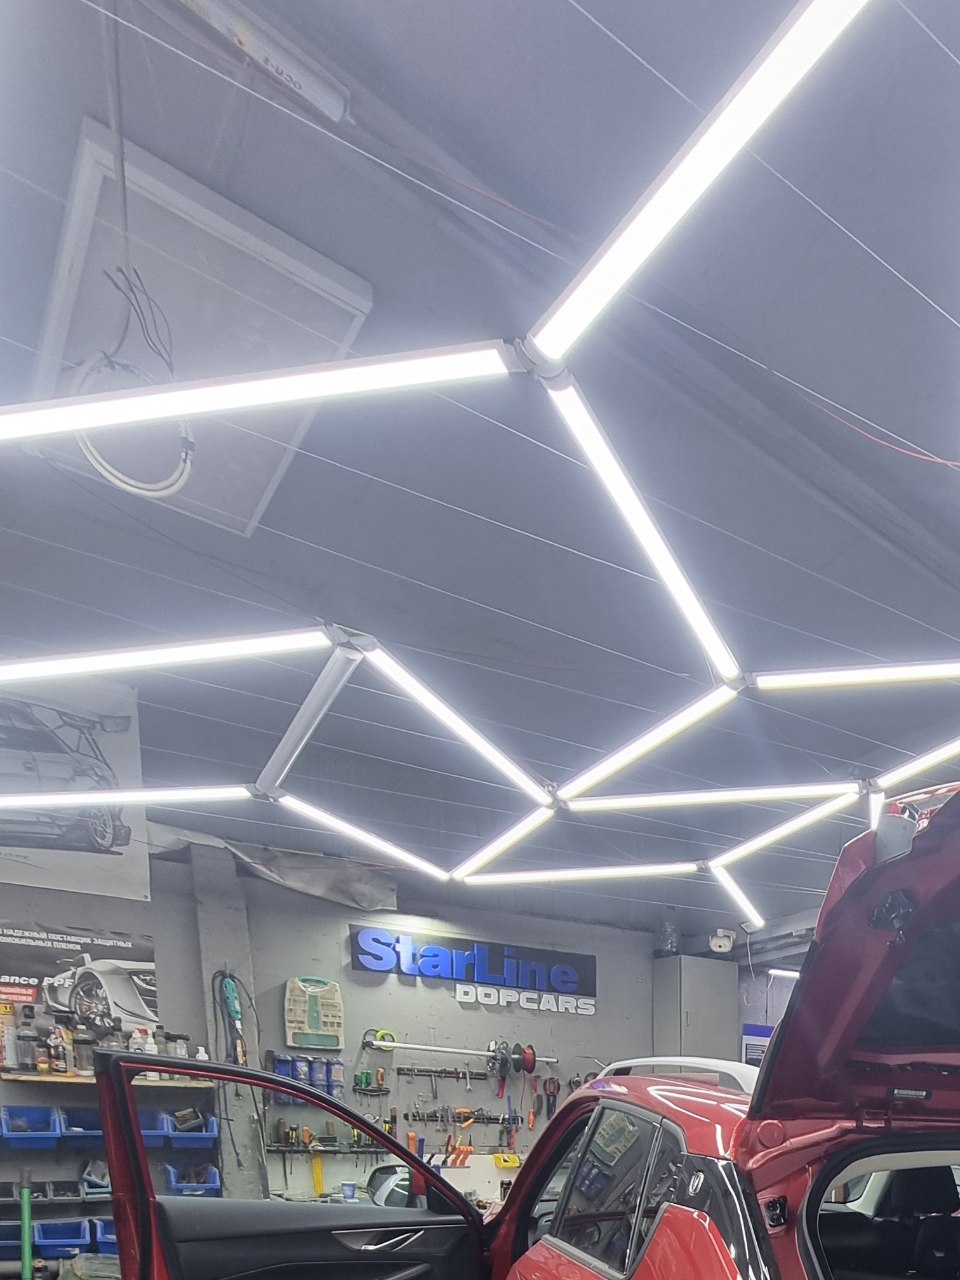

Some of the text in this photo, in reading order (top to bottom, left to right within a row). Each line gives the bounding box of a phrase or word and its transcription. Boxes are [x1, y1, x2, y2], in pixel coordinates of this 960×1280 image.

[48, 932, 92, 944] ПОСТАВЩИК
[93, 937, 133, 948] ЗАЩИТНЫХ
[357, 927, 580, 993] StarLine
[42, 976, 75, 988] PPF
[456, 983, 597, 1016] DOPCARS
